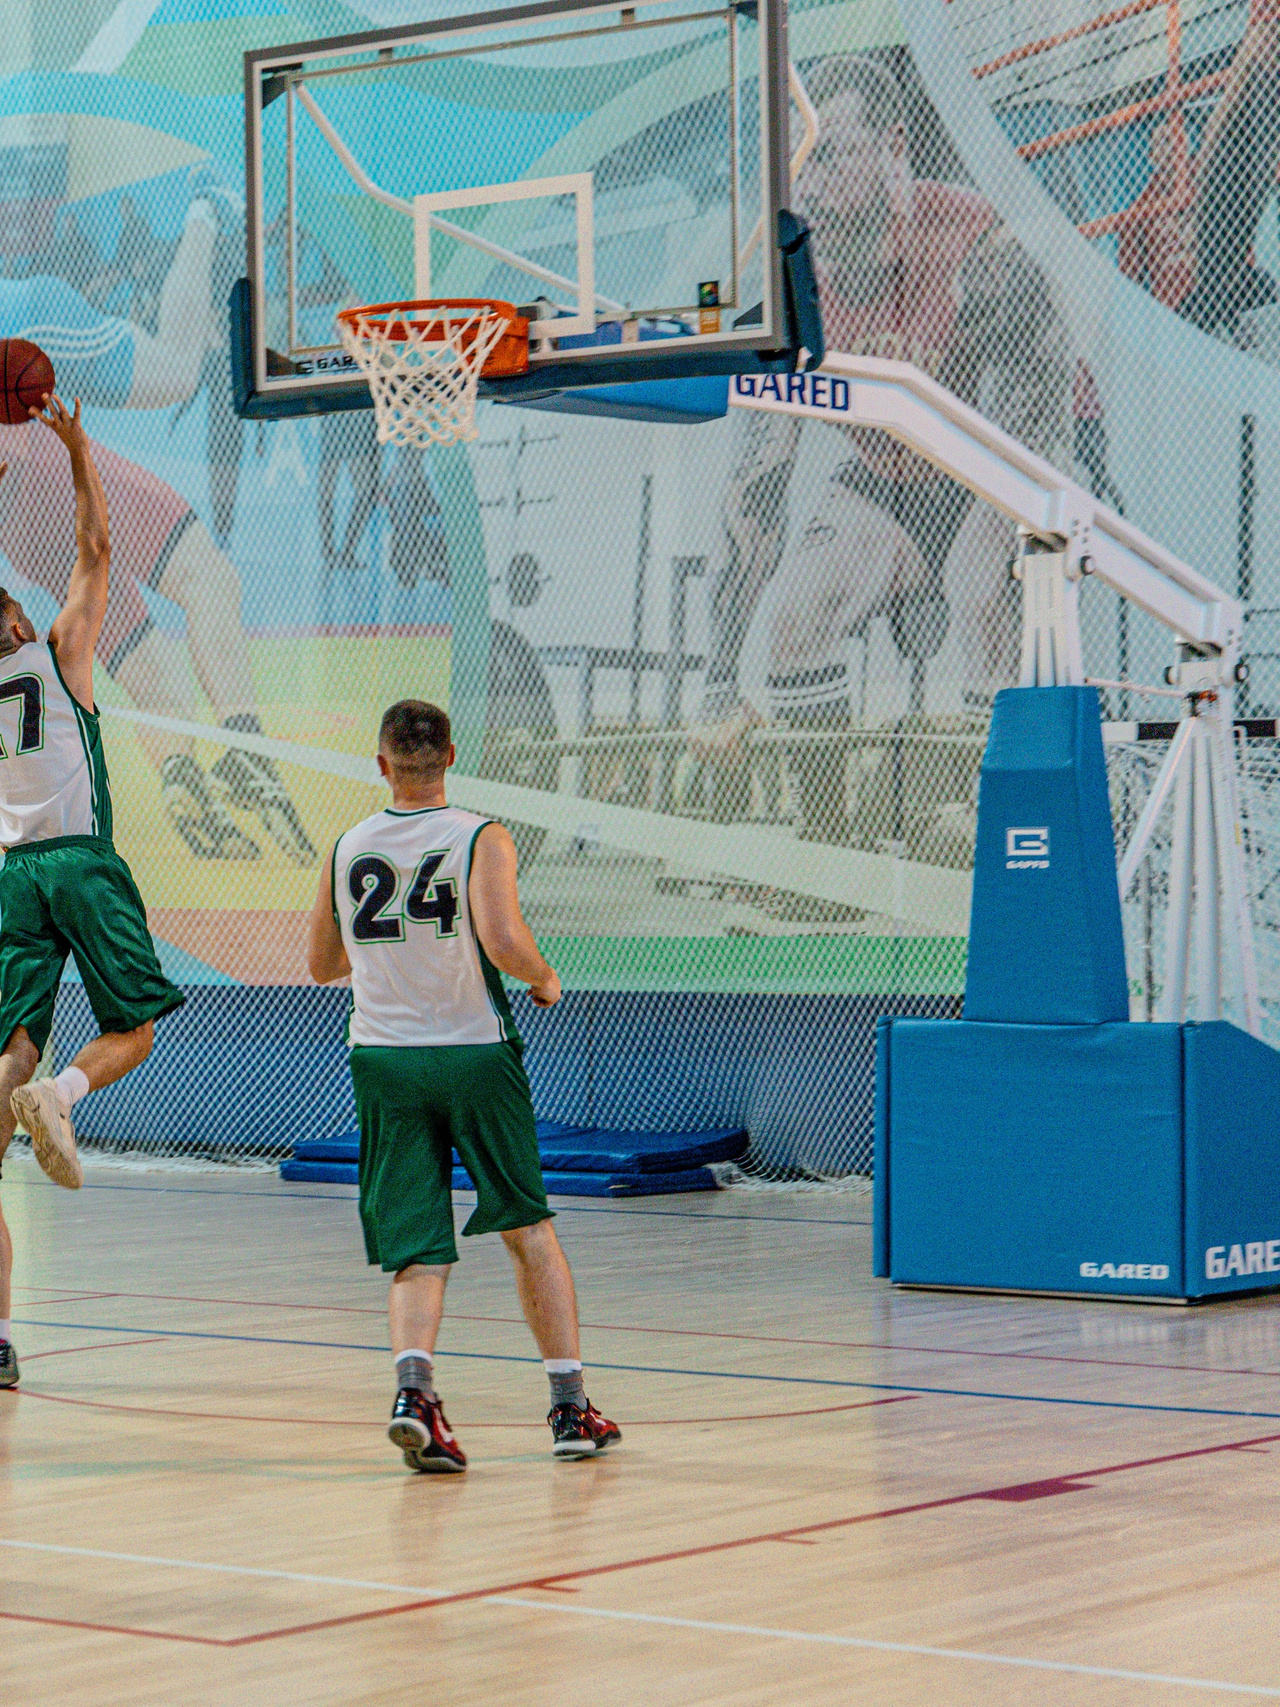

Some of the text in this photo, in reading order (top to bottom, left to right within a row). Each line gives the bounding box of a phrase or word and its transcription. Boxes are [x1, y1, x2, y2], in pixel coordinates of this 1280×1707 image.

[735, 372, 849, 411] GARED
[345, 849, 462, 945] 24
[1079, 1262, 1170, 1280] GARED
